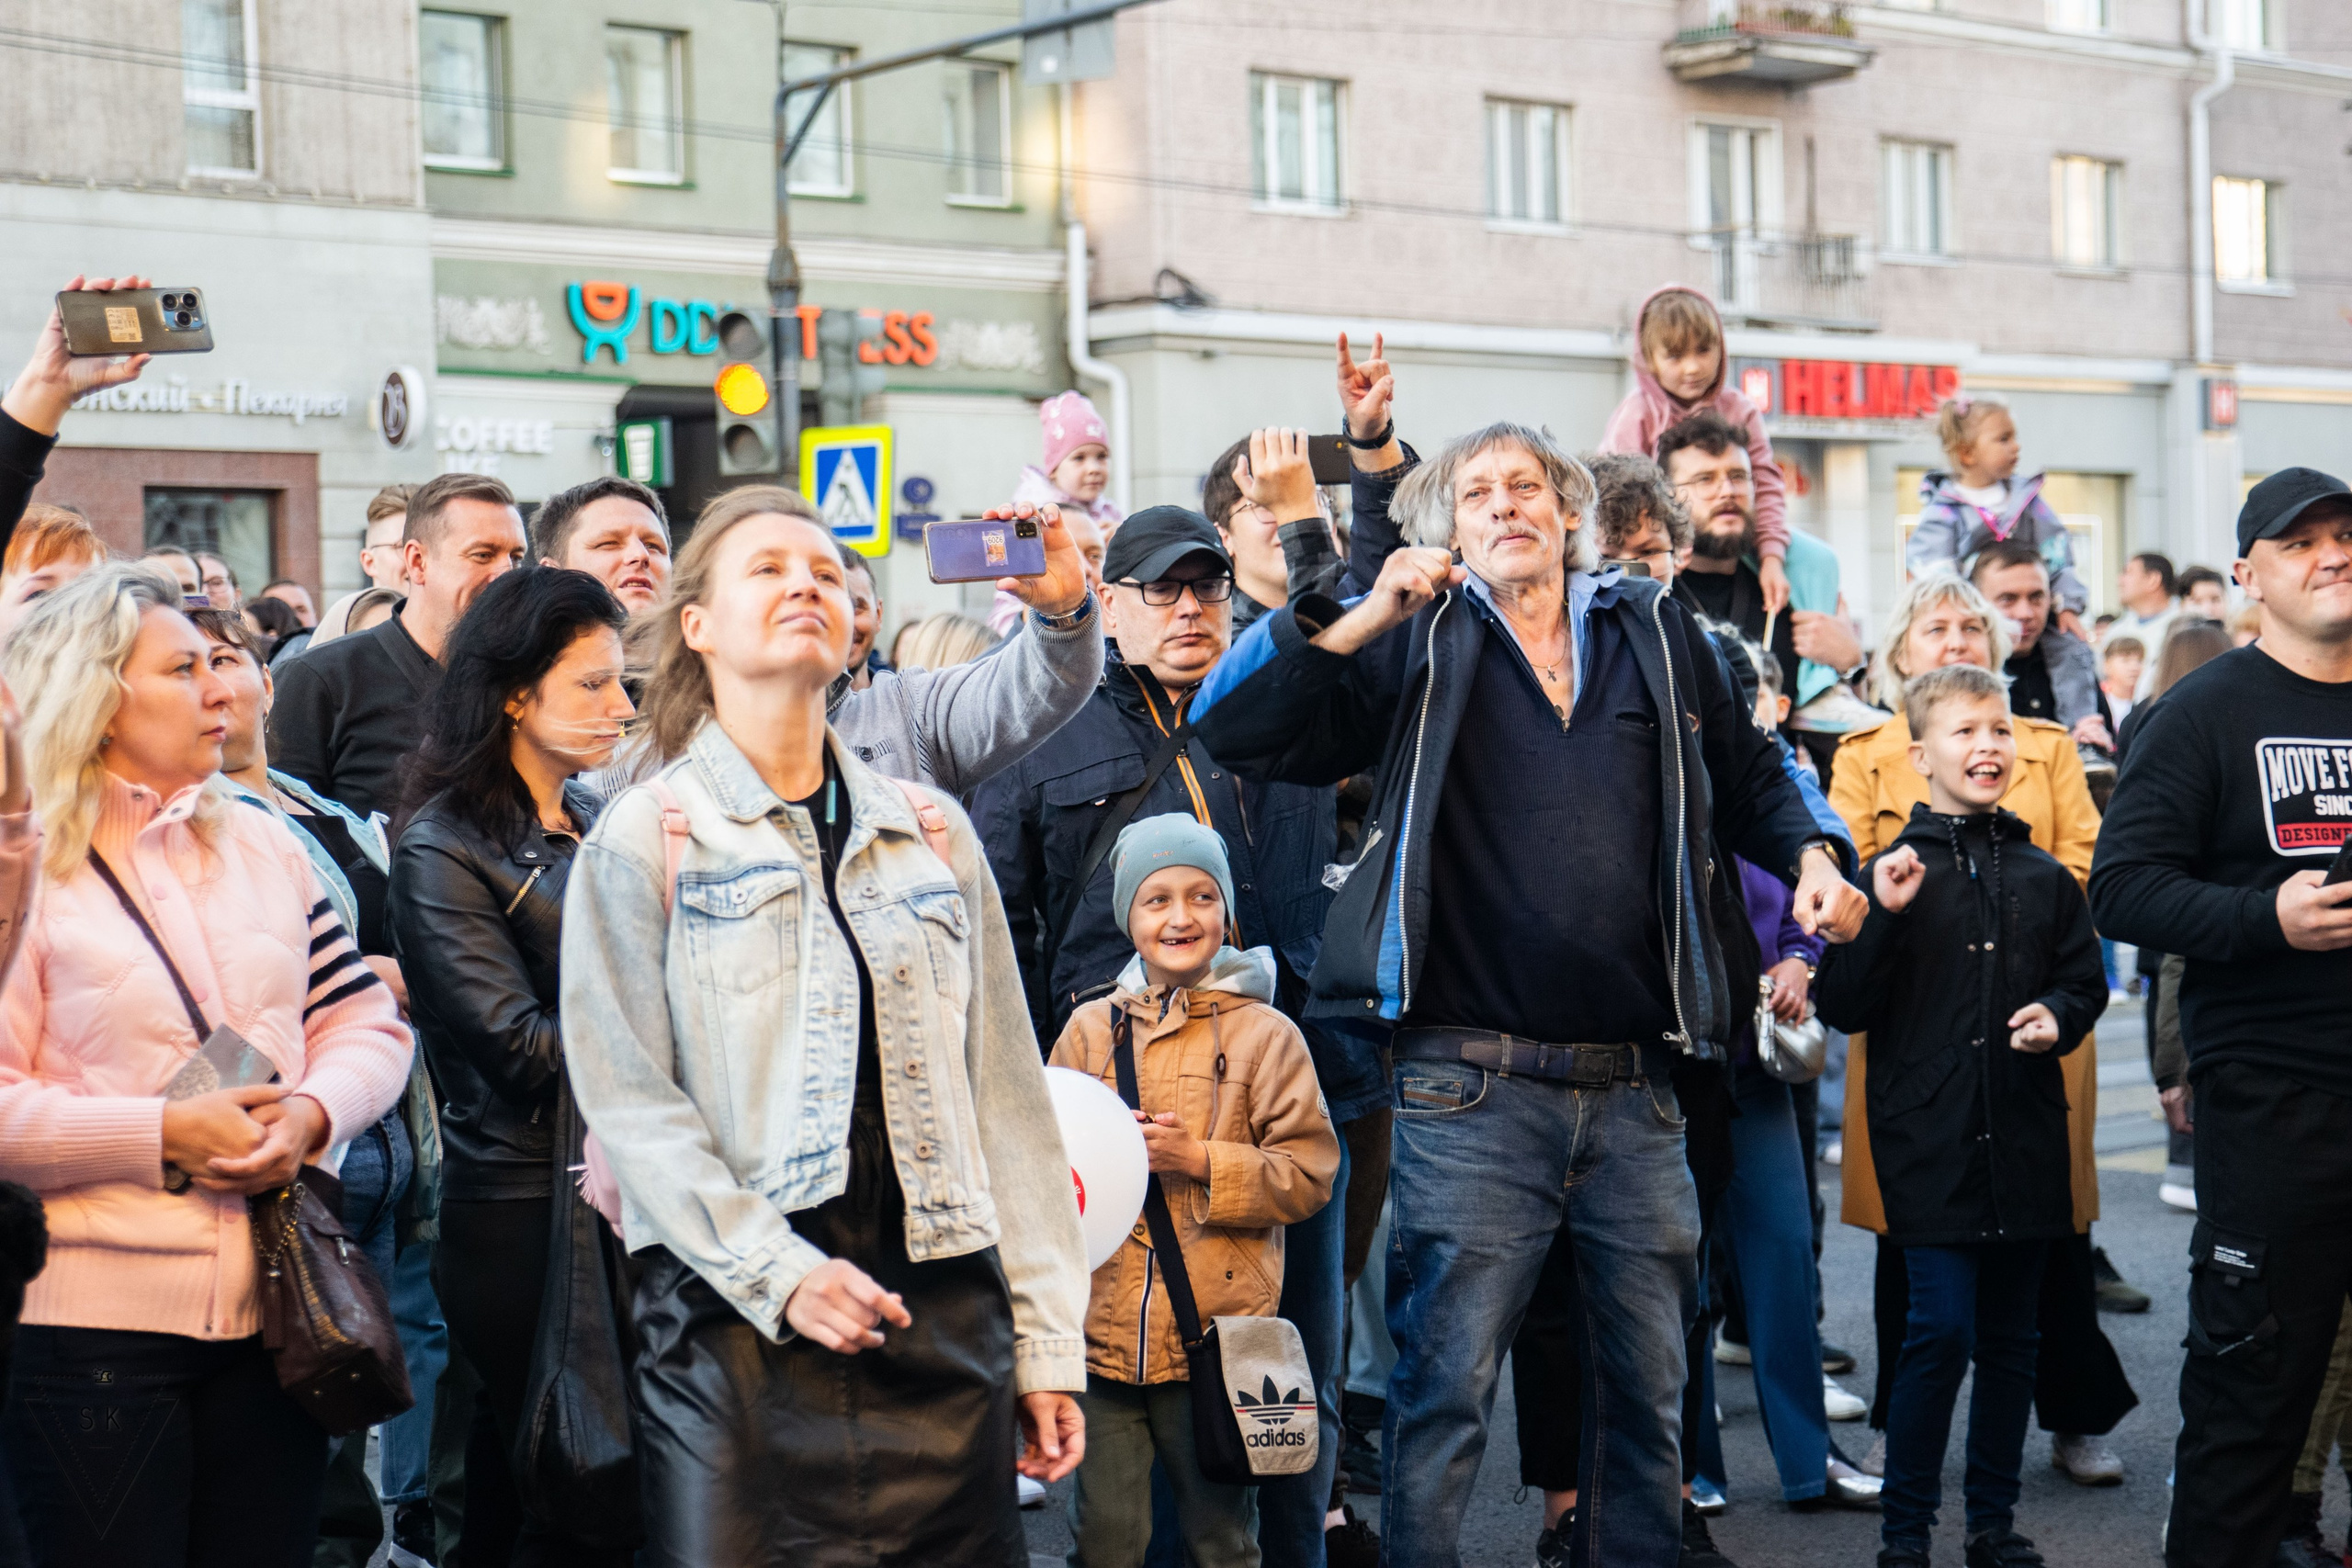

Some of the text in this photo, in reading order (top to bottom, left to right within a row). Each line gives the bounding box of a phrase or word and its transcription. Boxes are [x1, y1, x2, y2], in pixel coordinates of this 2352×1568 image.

[2265, 746, 2352, 802] MOVE F
[1246, 1428, 1306, 1448] adidas
